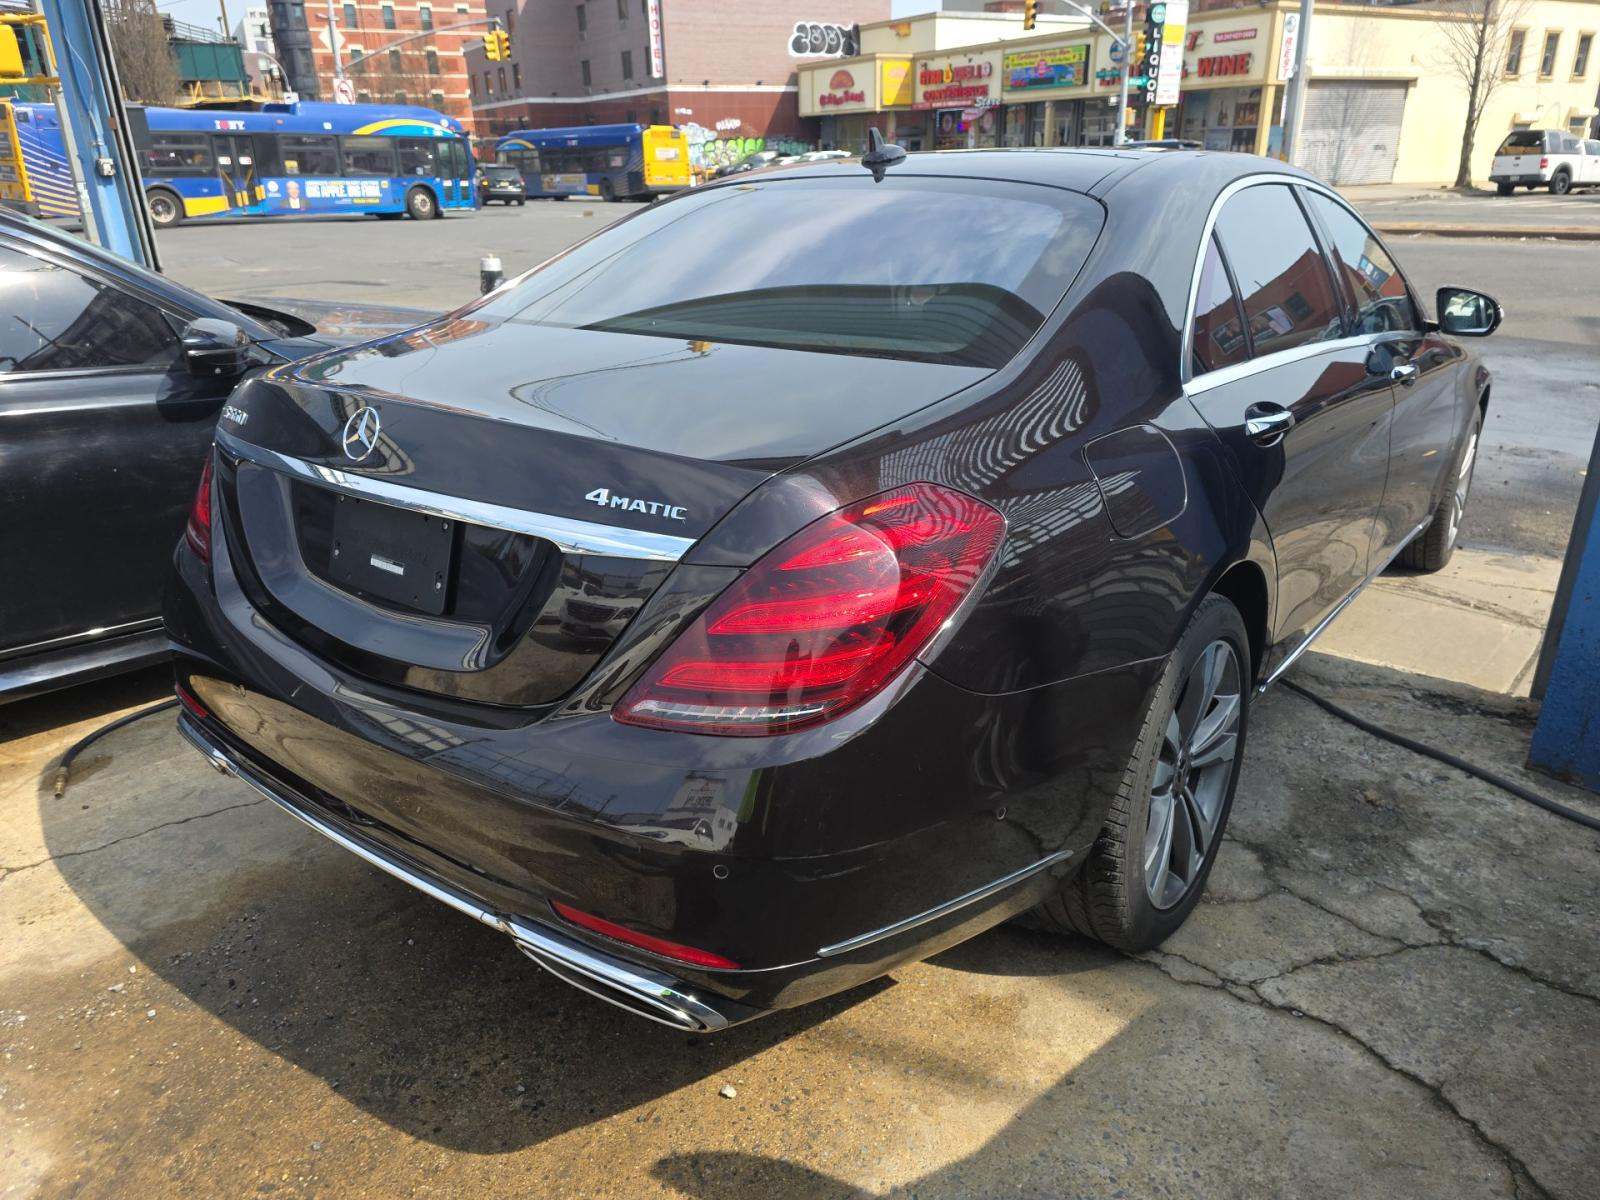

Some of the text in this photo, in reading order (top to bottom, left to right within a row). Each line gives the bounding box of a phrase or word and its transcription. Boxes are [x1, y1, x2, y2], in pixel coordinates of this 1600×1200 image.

[651, 5, 661, 73] HOTEL
[1146, 28, 1160, 102] LIQUOR
[1198, 53, 1251, 77] WINE
[585, 487, 688, 520] 4MATIC
